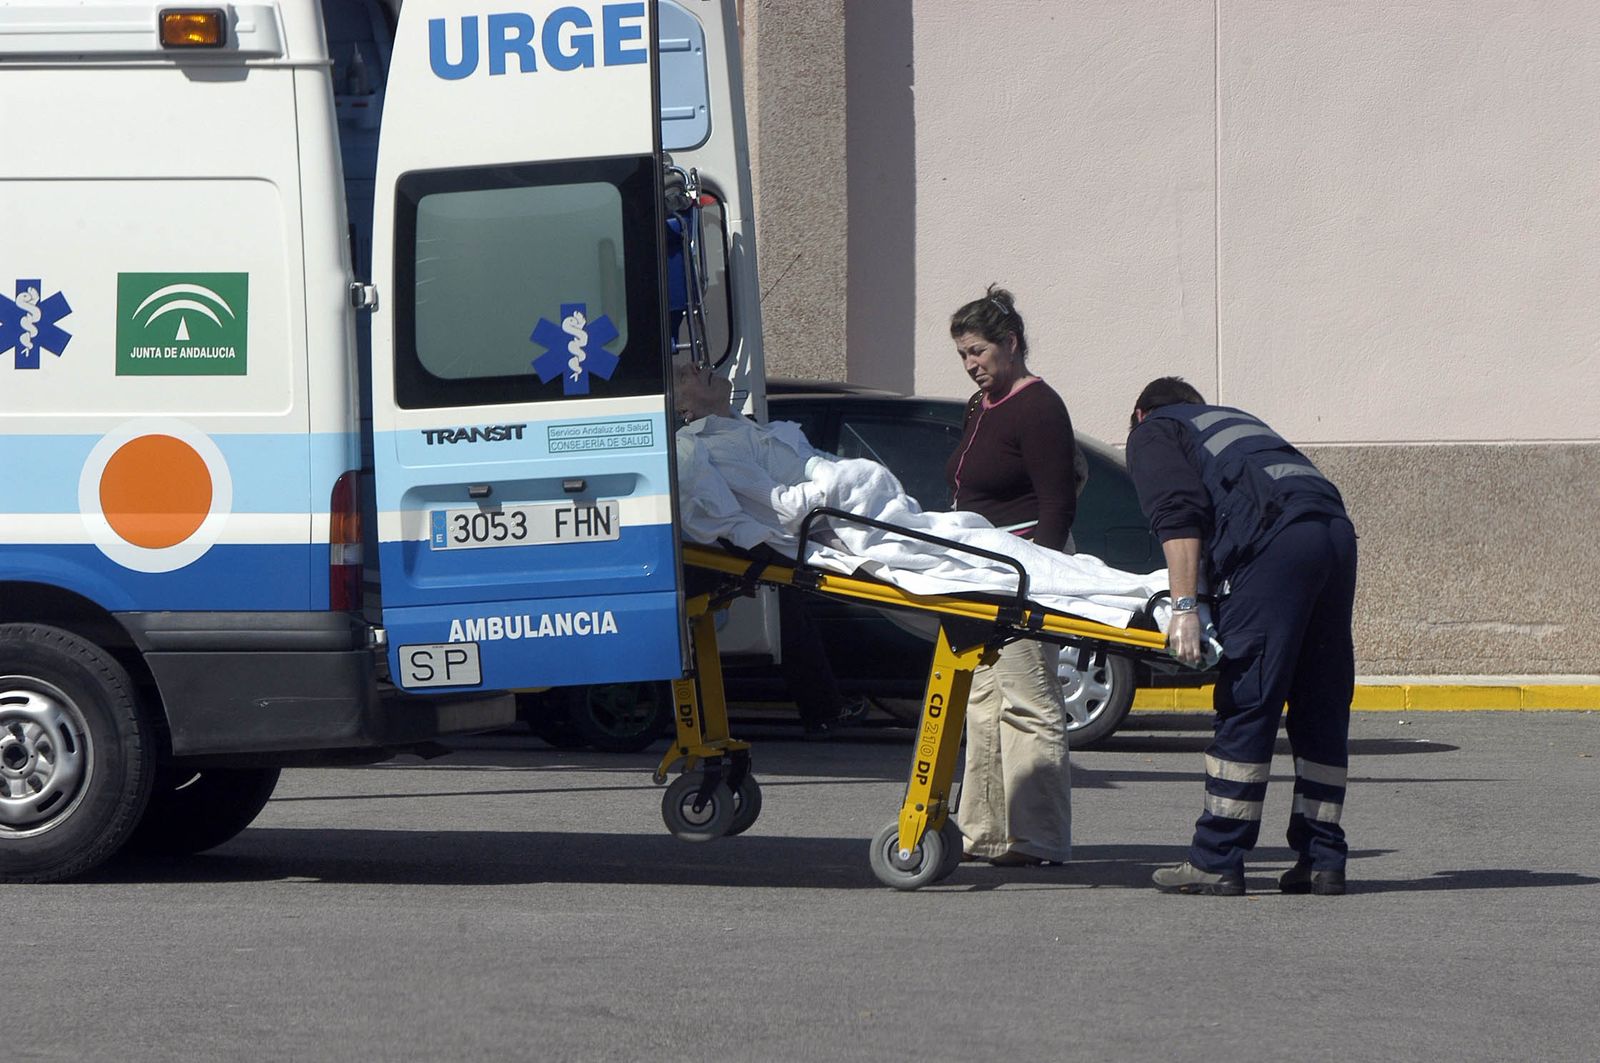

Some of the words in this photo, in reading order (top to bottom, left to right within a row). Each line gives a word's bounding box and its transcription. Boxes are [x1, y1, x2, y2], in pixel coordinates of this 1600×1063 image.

[428, 2, 648, 80] URGE
[130, 346, 162, 358] JUNTA
[164, 346, 178, 358] DE
[179, 346, 236, 359] ANDALUCIA
[421, 424, 527, 445] TRANSIT
[550, 428, 581, 437] Servicio
[582, 425, 615, 435] Andaluz
[615, 424, 626, 433] de
[627, 423, 649, 432] Salud
[607, 438, 620, 448] DE
[621, 435, 650, 447] SALUD
[453, 511, 528, 543] 3053
[555, 506, 611, 538] FHN
[436, 533, 443, 543] E
[448, 611, 618, 643] AMBULANCIA
[929, 693, 943, 718] CD
[920, 721, 939, 757] 210
[916, 760, 931, 785] DP
